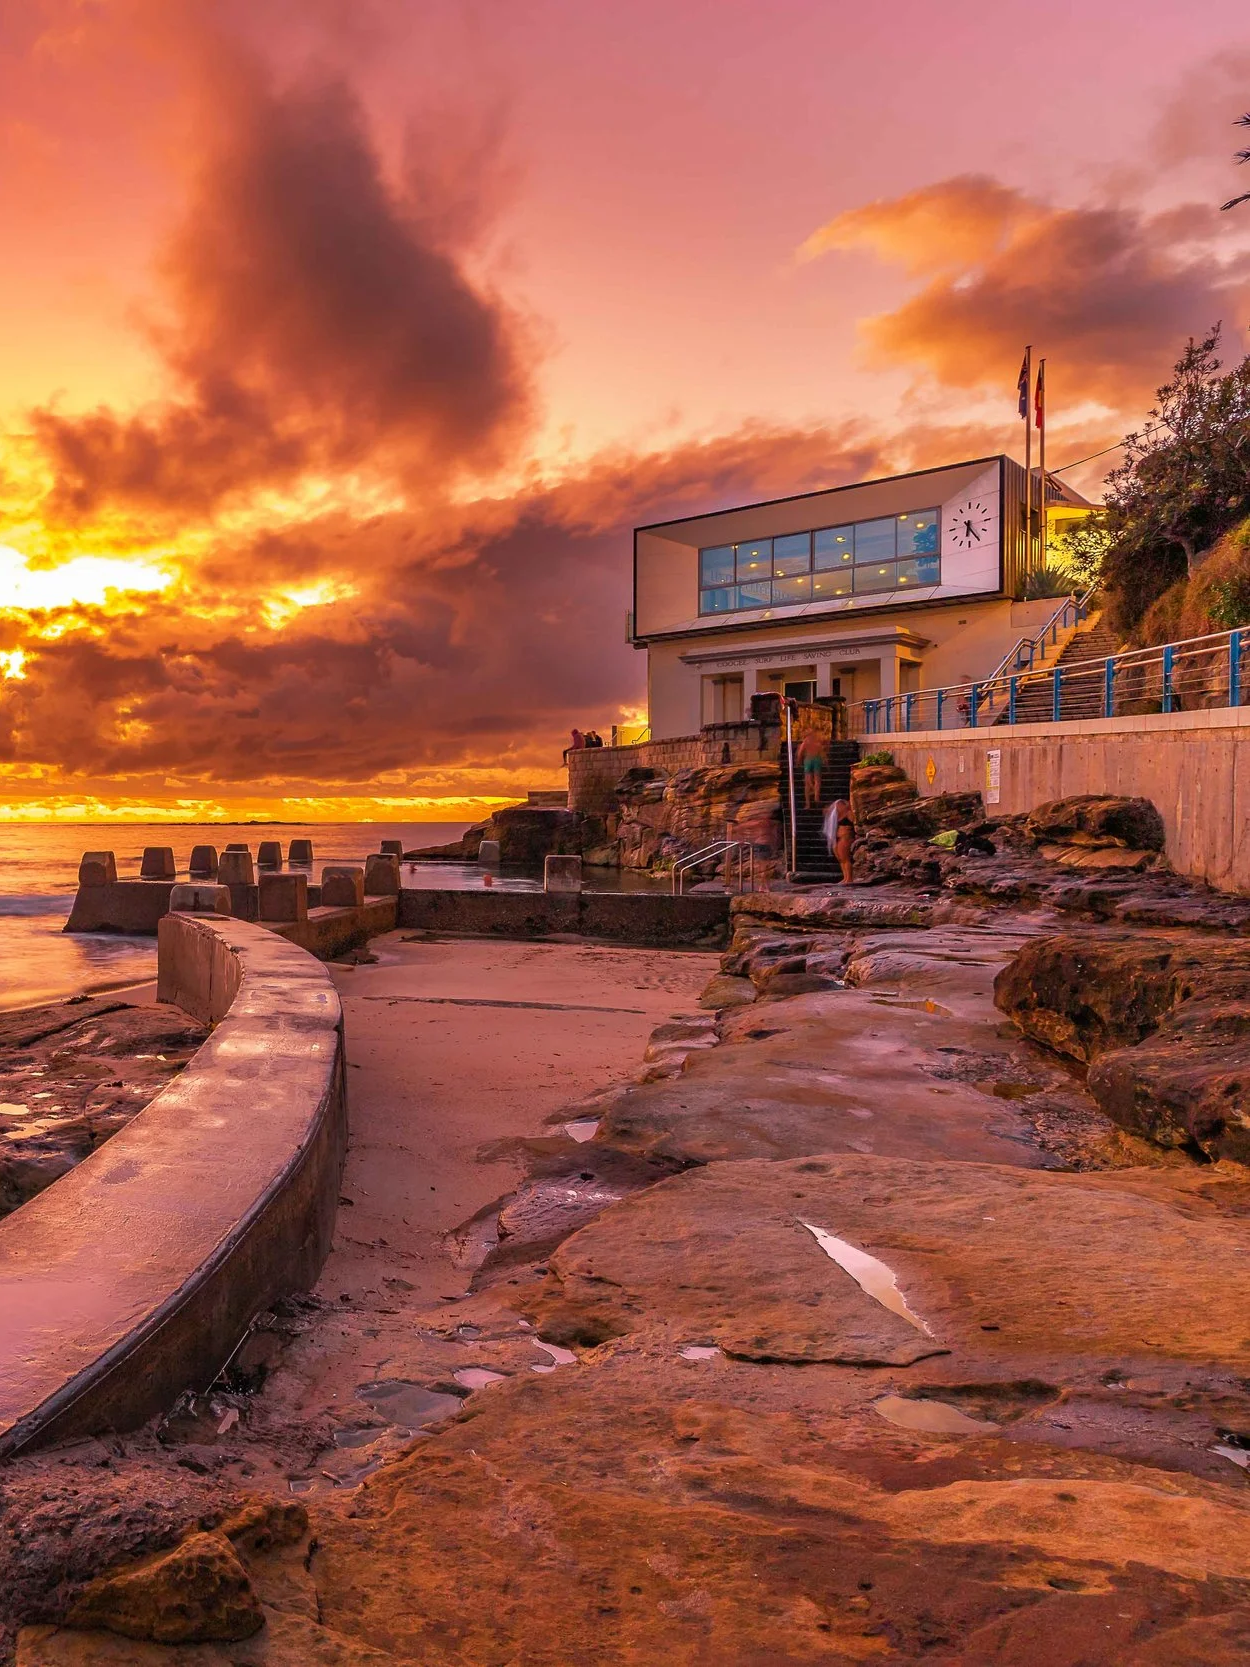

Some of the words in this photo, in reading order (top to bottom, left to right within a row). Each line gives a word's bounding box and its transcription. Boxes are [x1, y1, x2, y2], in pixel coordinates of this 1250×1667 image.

[754, 655, 772, 664] SURF
[780, 654, 796, 662] LIFE
[803, 650, 831, 659] SAVING
[838, 648, 860, 656] CLUB
